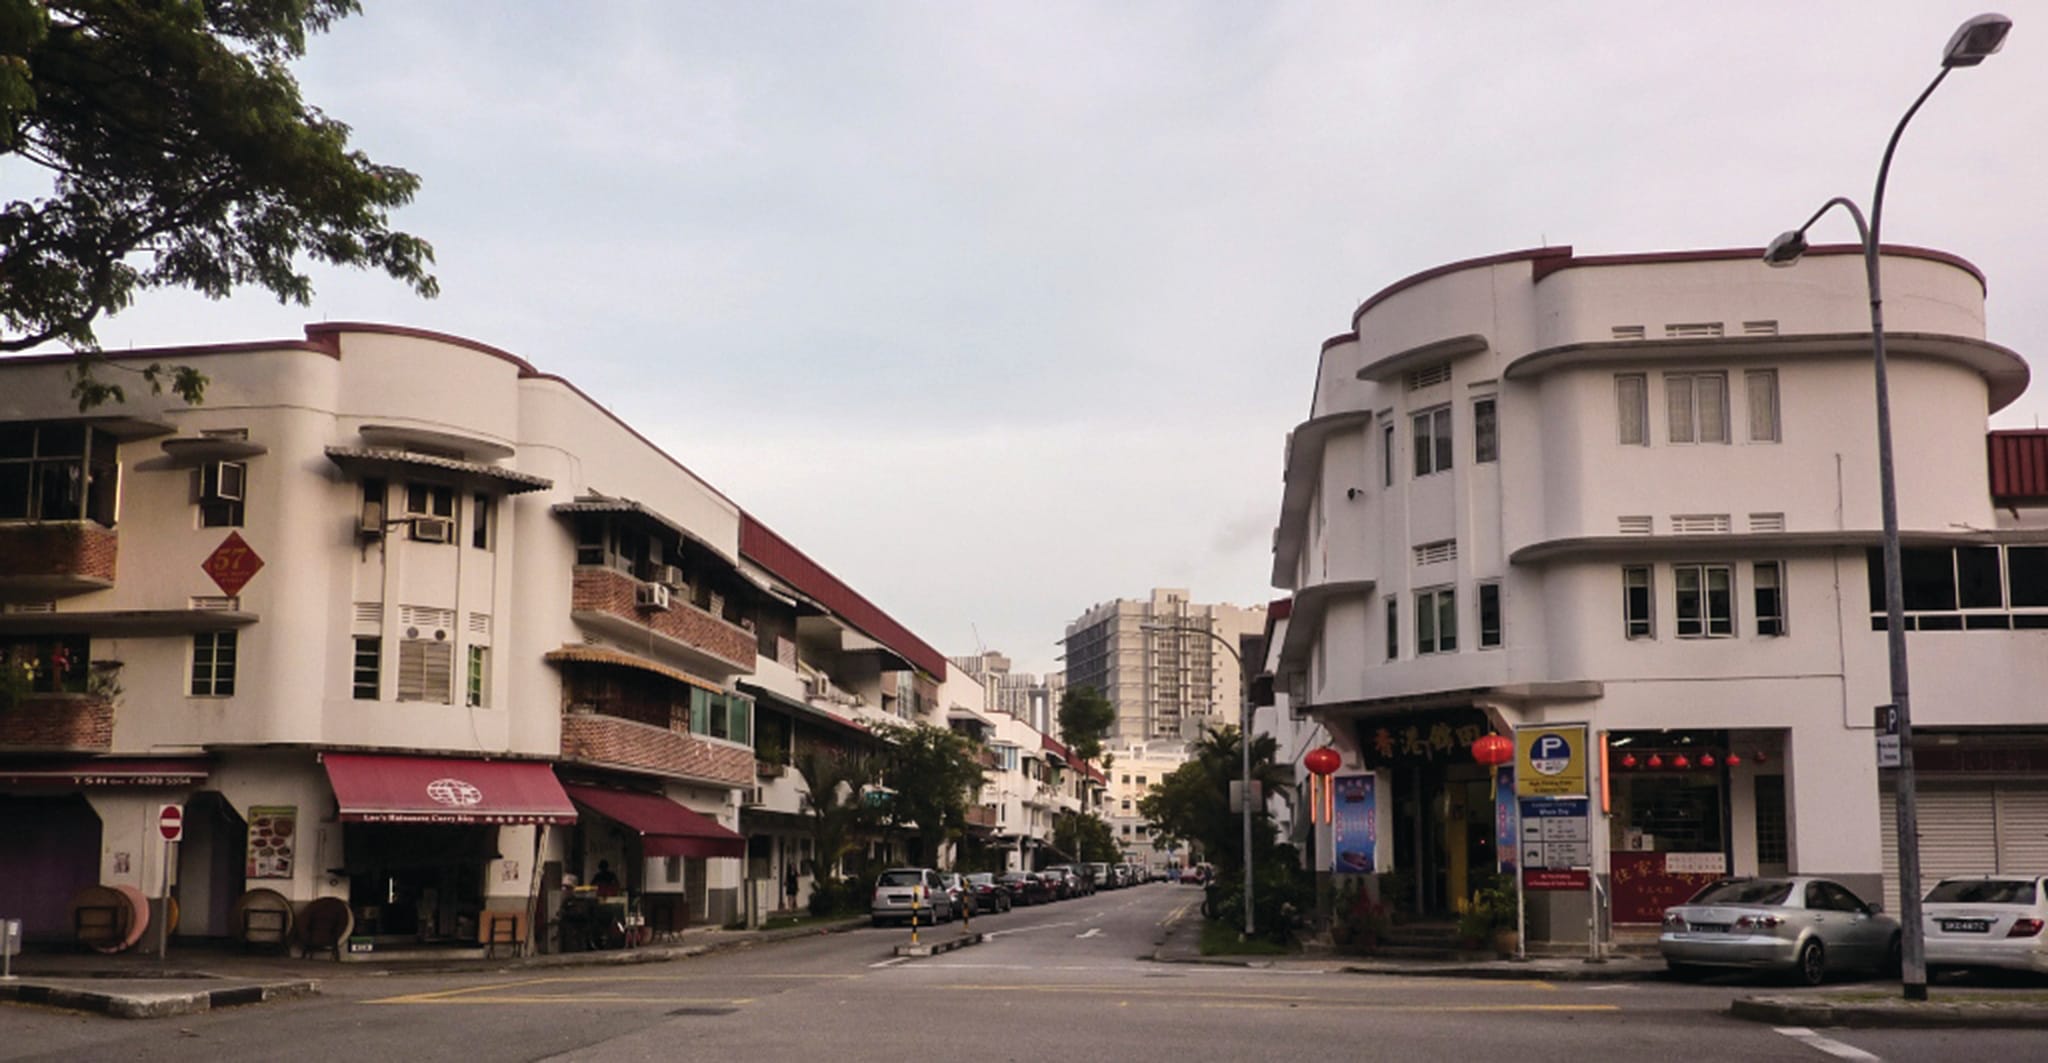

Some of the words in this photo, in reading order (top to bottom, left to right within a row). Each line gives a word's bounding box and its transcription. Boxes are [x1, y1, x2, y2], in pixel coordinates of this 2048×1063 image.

[214, 547, 248, 569] 57
[1888, 709, 1898, 731] P
[1542, 738, 1563, 758] P
